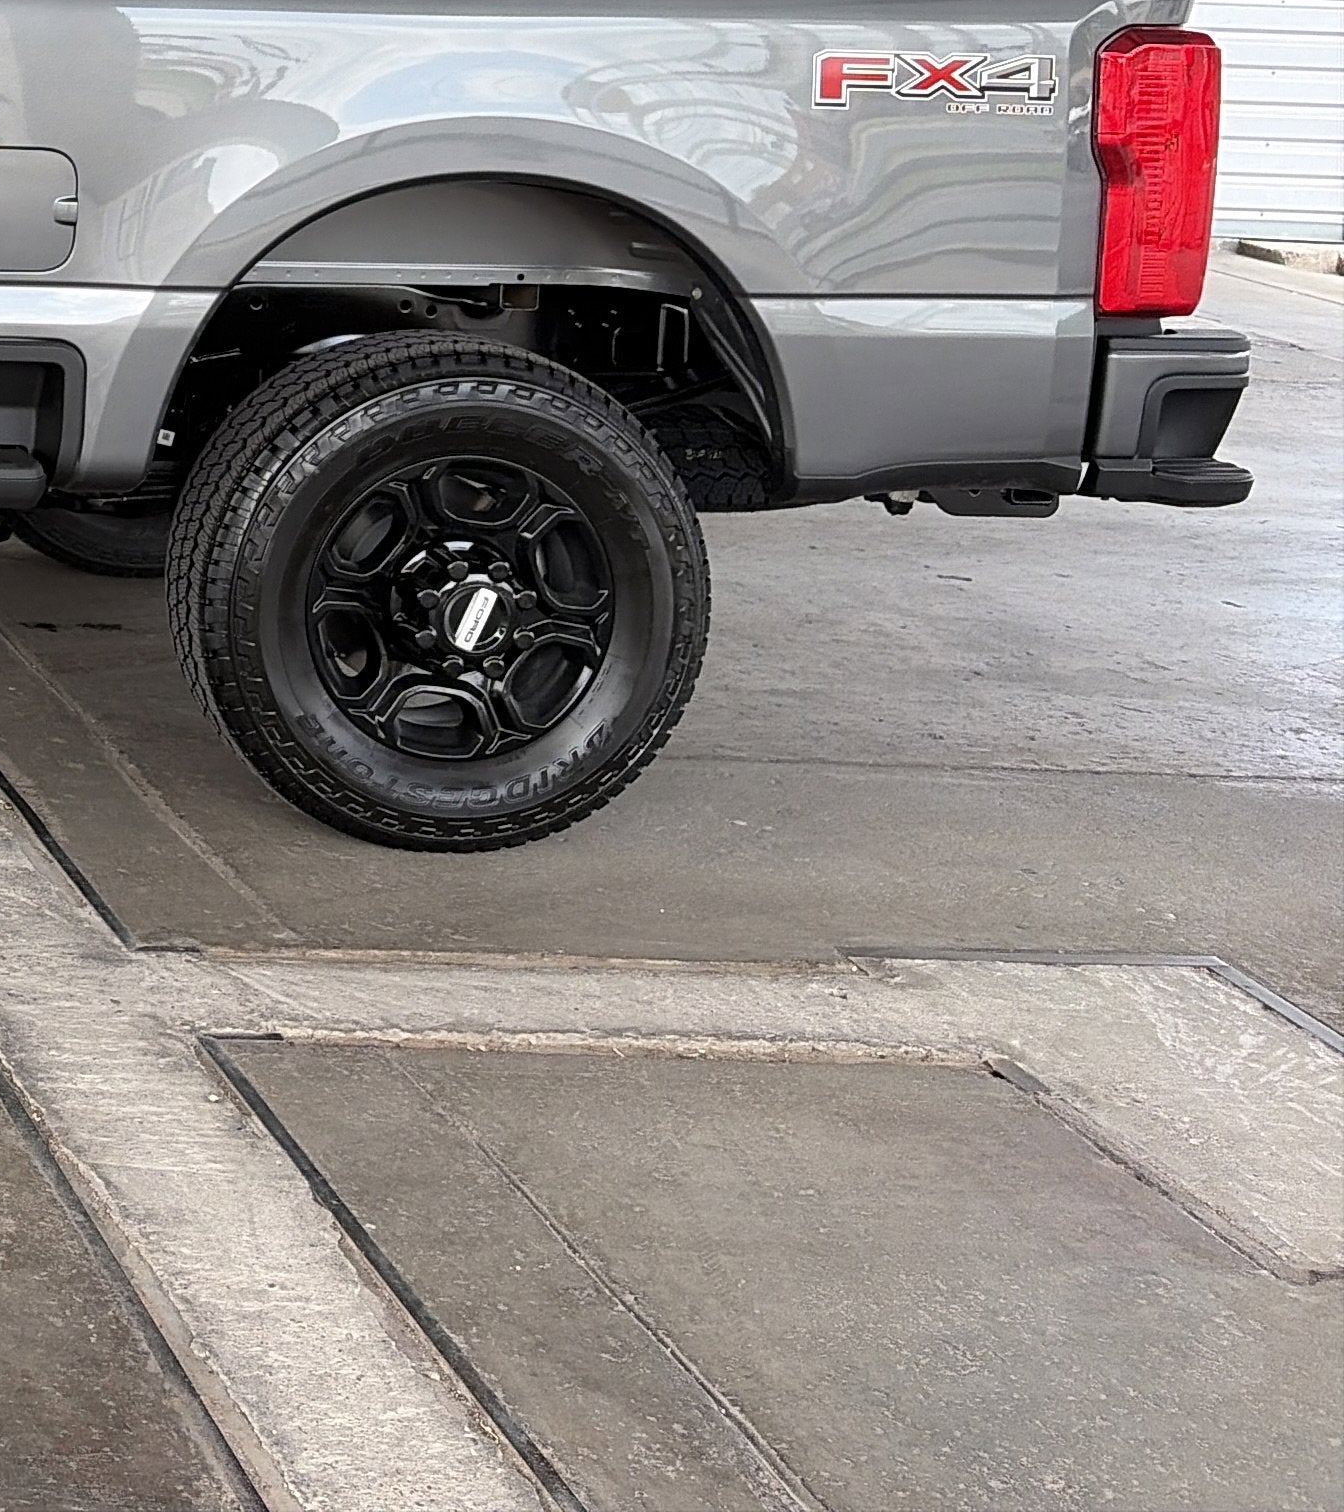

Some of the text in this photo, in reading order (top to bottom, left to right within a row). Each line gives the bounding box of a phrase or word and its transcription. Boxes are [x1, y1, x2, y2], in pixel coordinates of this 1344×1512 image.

[812, 49, 1058, 110] FX4
[946, 102, 1054, 116] OFF ROAD
